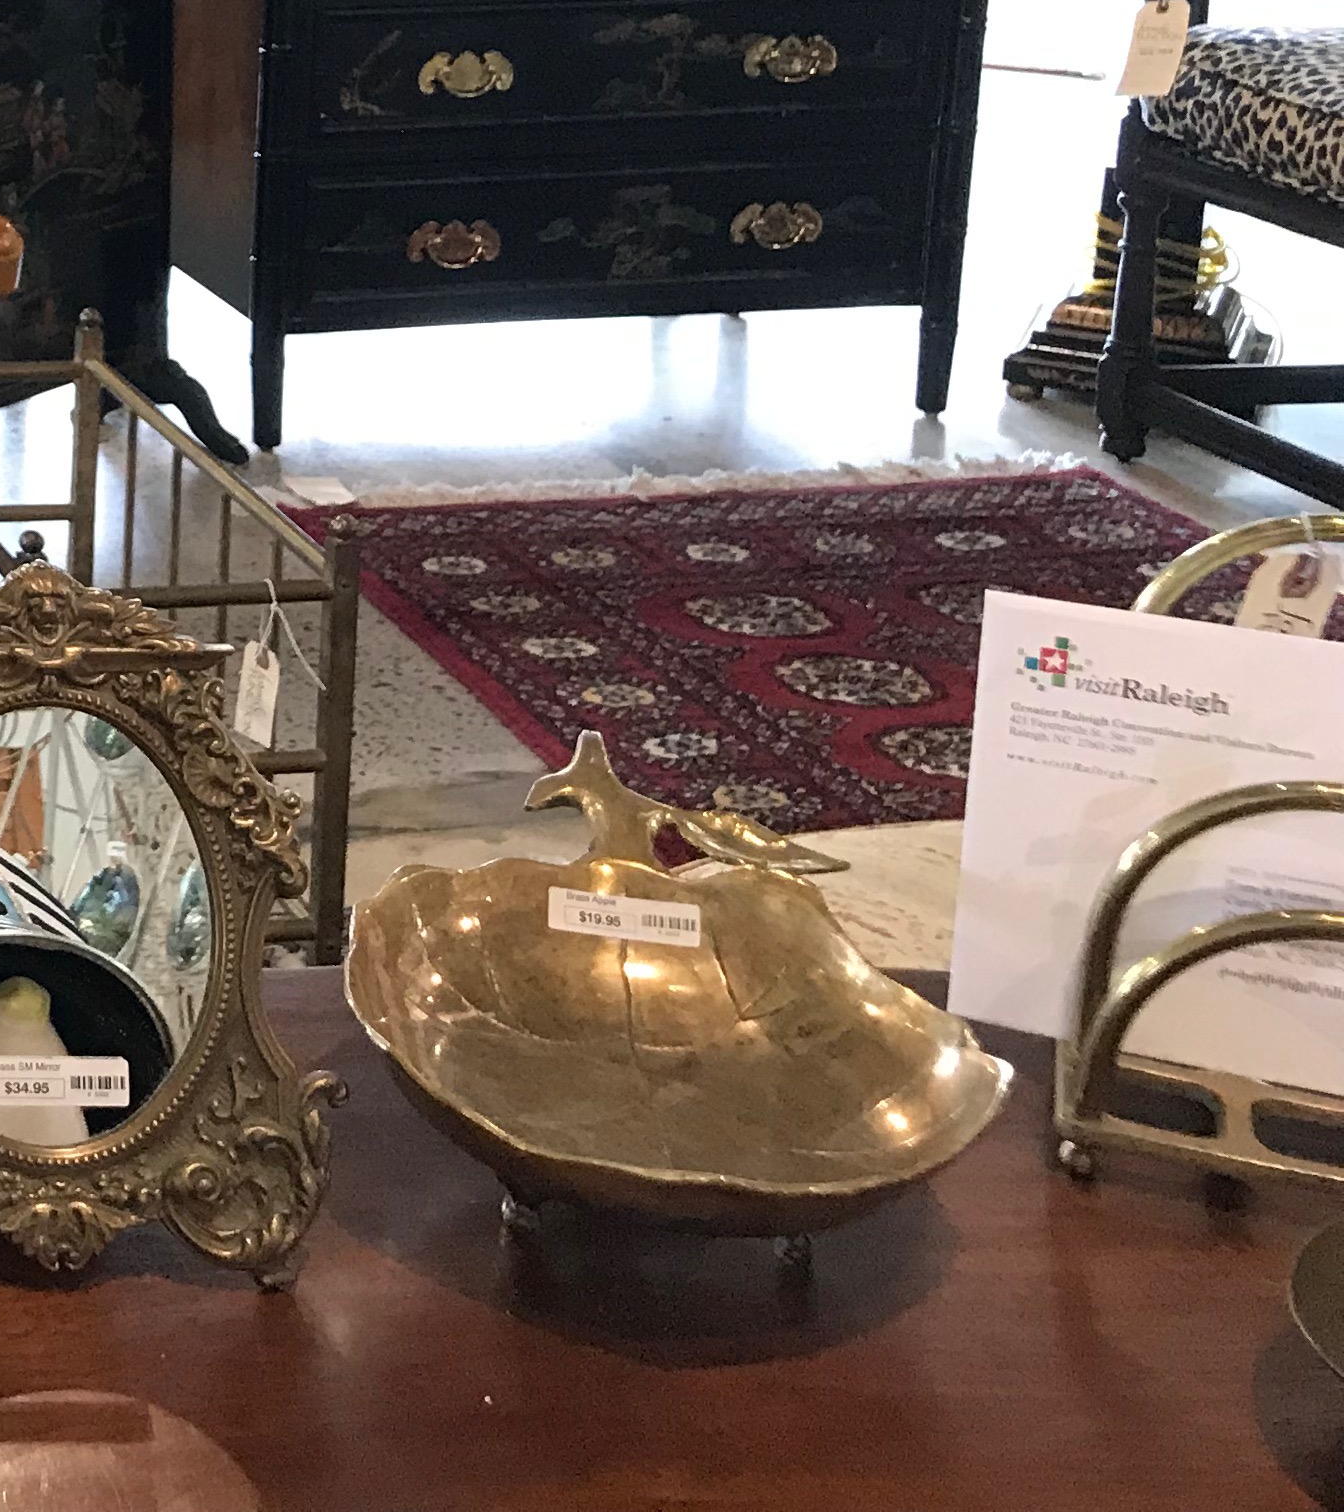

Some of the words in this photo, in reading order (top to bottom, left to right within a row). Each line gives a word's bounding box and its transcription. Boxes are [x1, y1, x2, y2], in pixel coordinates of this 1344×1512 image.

[1074, 674, 1230, 716] visitRaleigh
[566, 890, 590, 902] Brass
[579, 910, 621, 928] $19.95
[18, 1062, 33, 1071] SM
[35, 1062, 61, 1071] Mirror
[4, 1081, 50, 1095] $34.95
